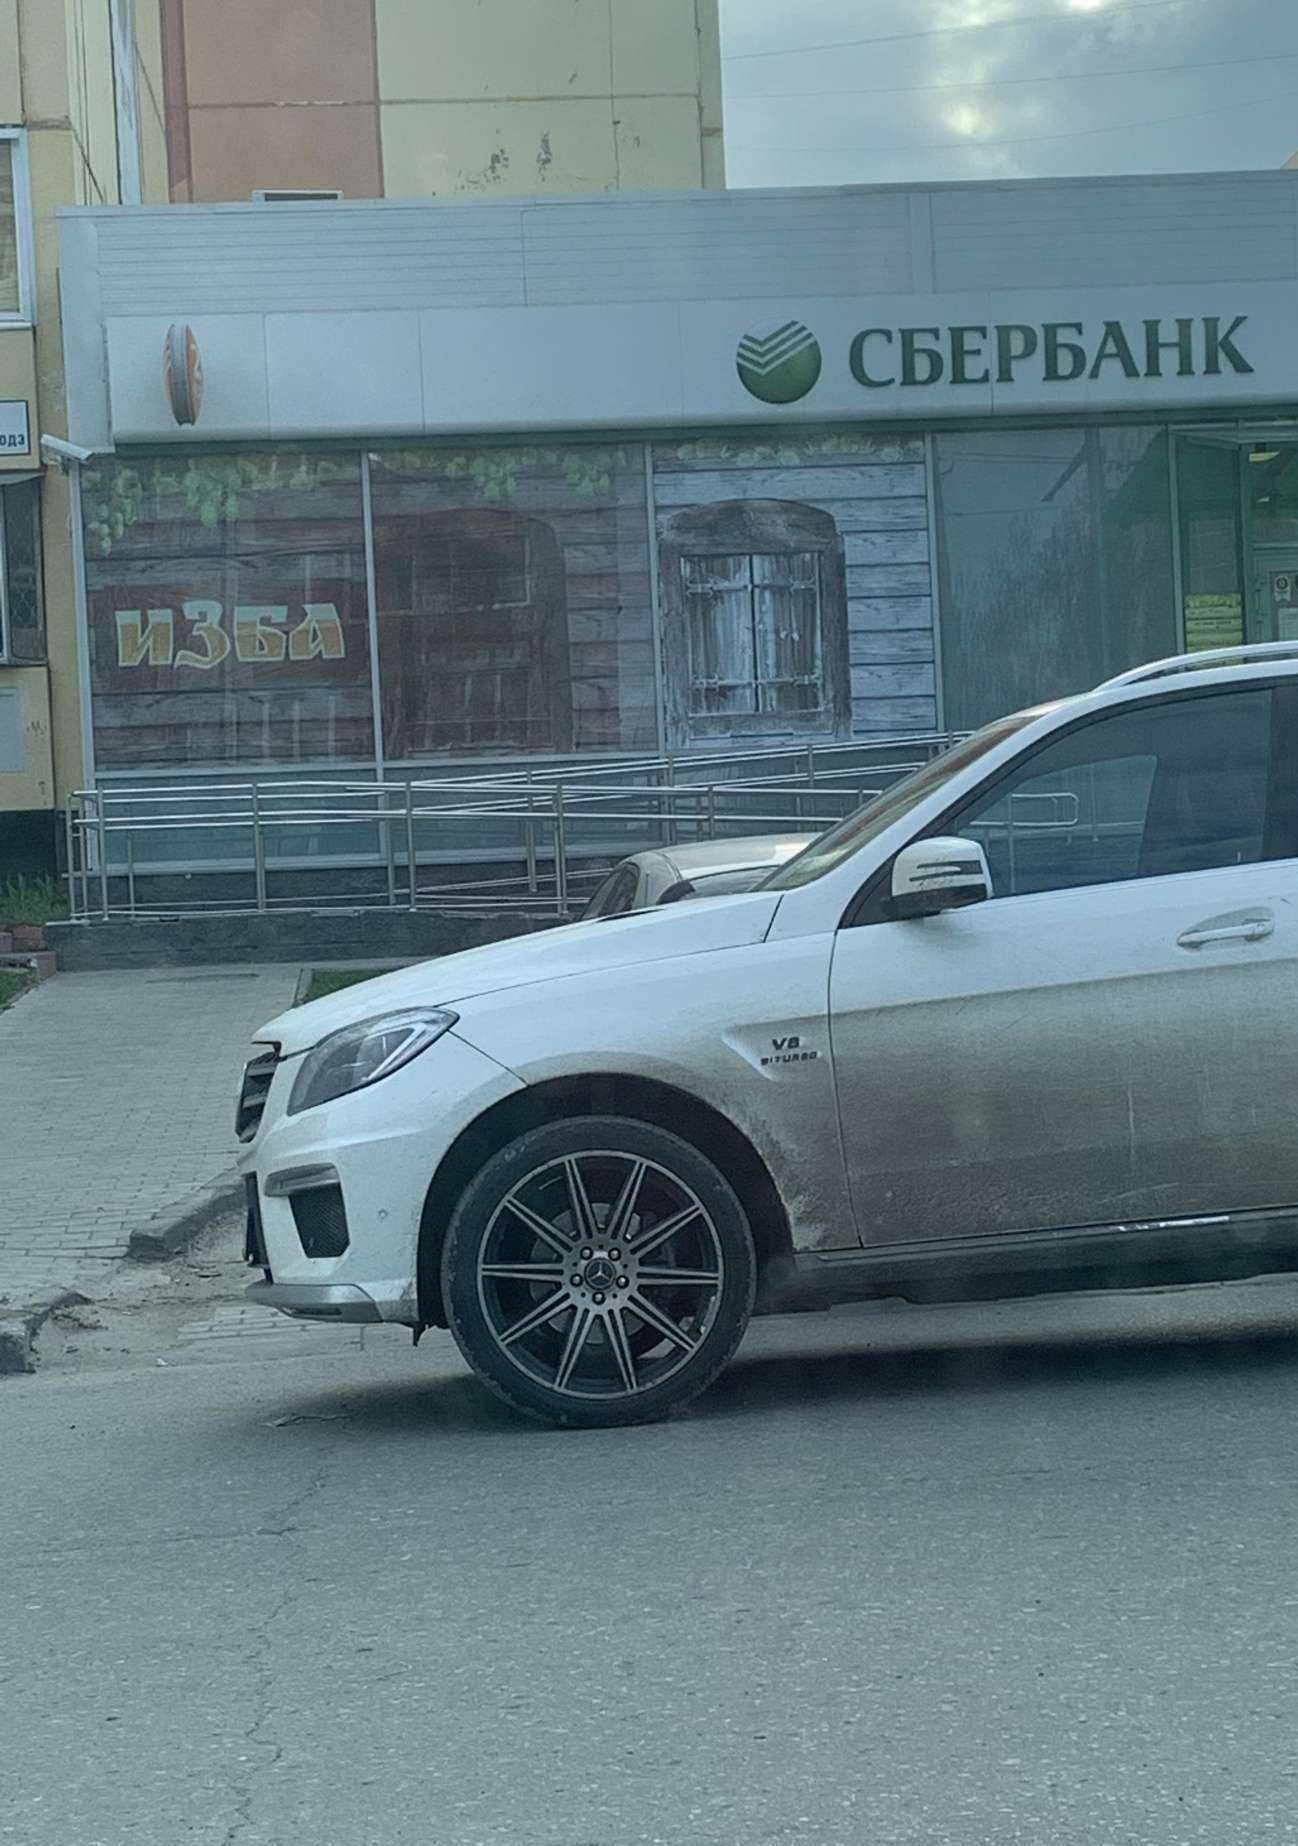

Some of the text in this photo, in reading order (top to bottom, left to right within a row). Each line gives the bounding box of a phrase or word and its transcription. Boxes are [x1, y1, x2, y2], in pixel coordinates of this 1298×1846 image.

[849, 315, 1255, 388] СБЕРБАНК
[772, 1036, 799, 1050] V8
[760, 1051, 818, 1066] BITURBO
